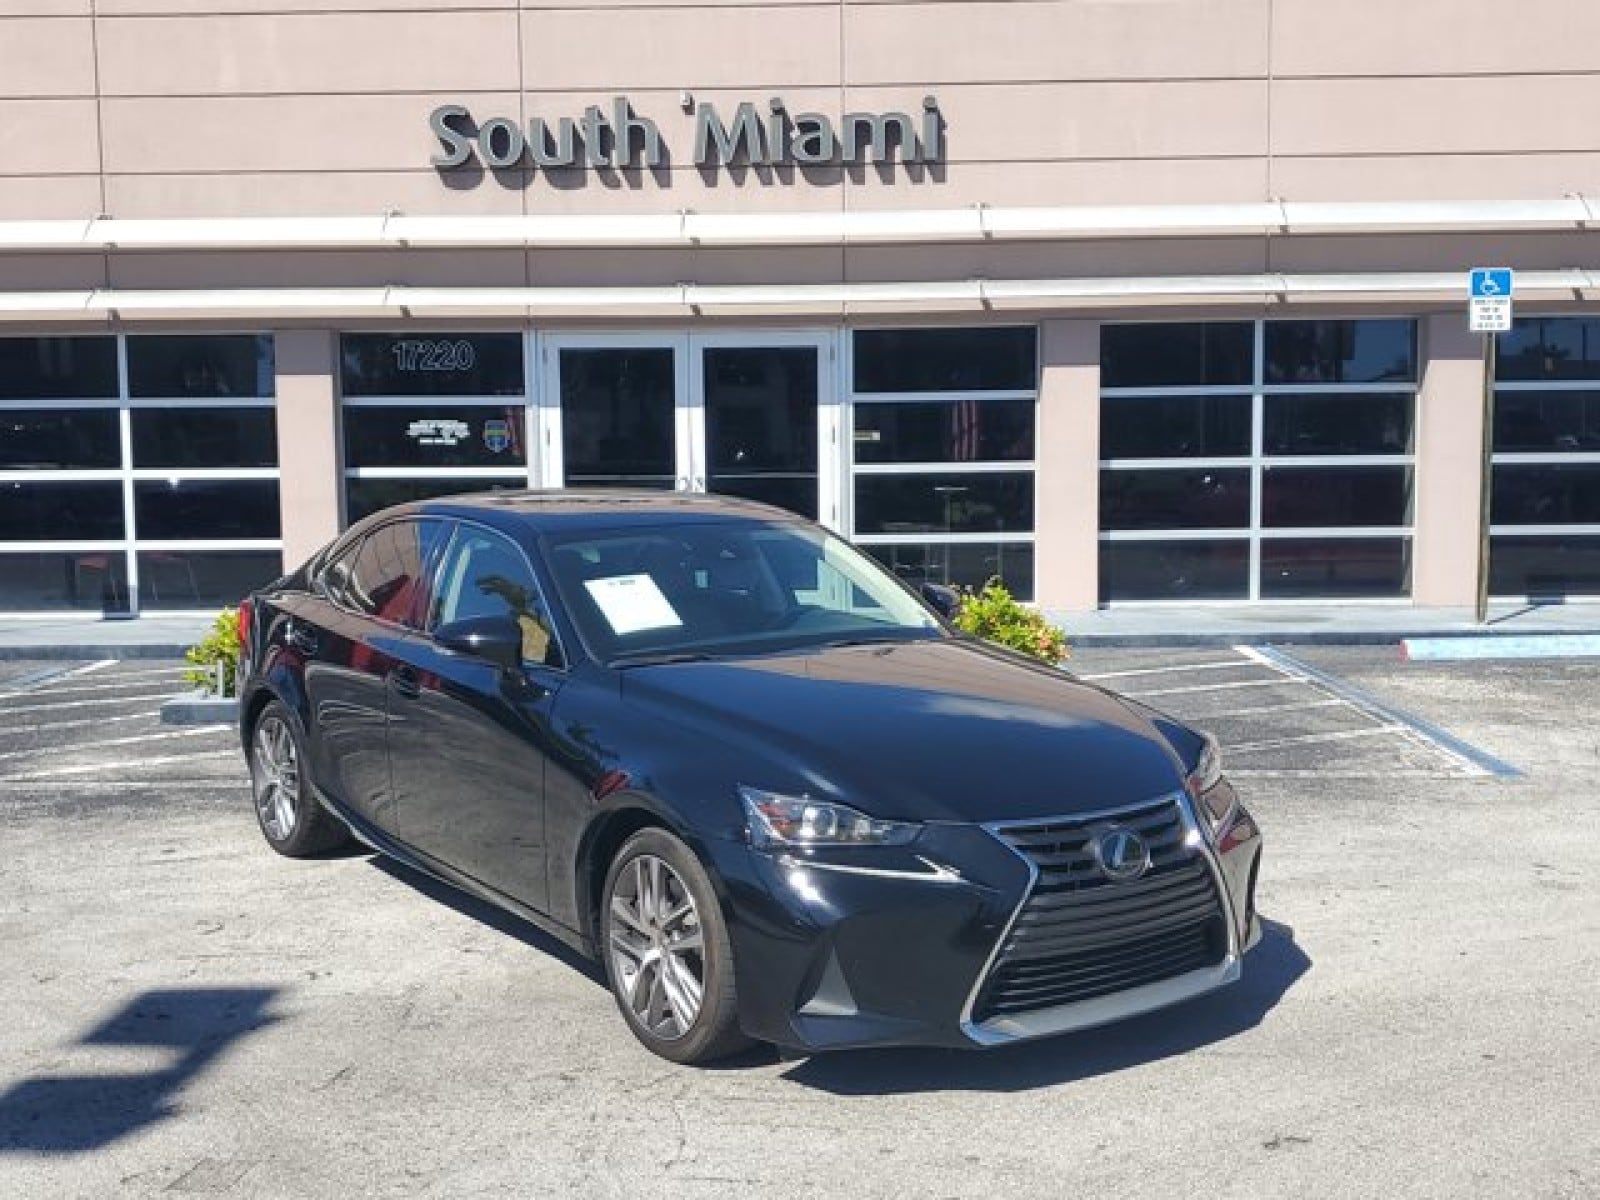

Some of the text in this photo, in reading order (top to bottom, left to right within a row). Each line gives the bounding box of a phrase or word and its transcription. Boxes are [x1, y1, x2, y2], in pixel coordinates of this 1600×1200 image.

[429, 96, 944, 168] South Miami
[392, 339, 475, 371] 17220
